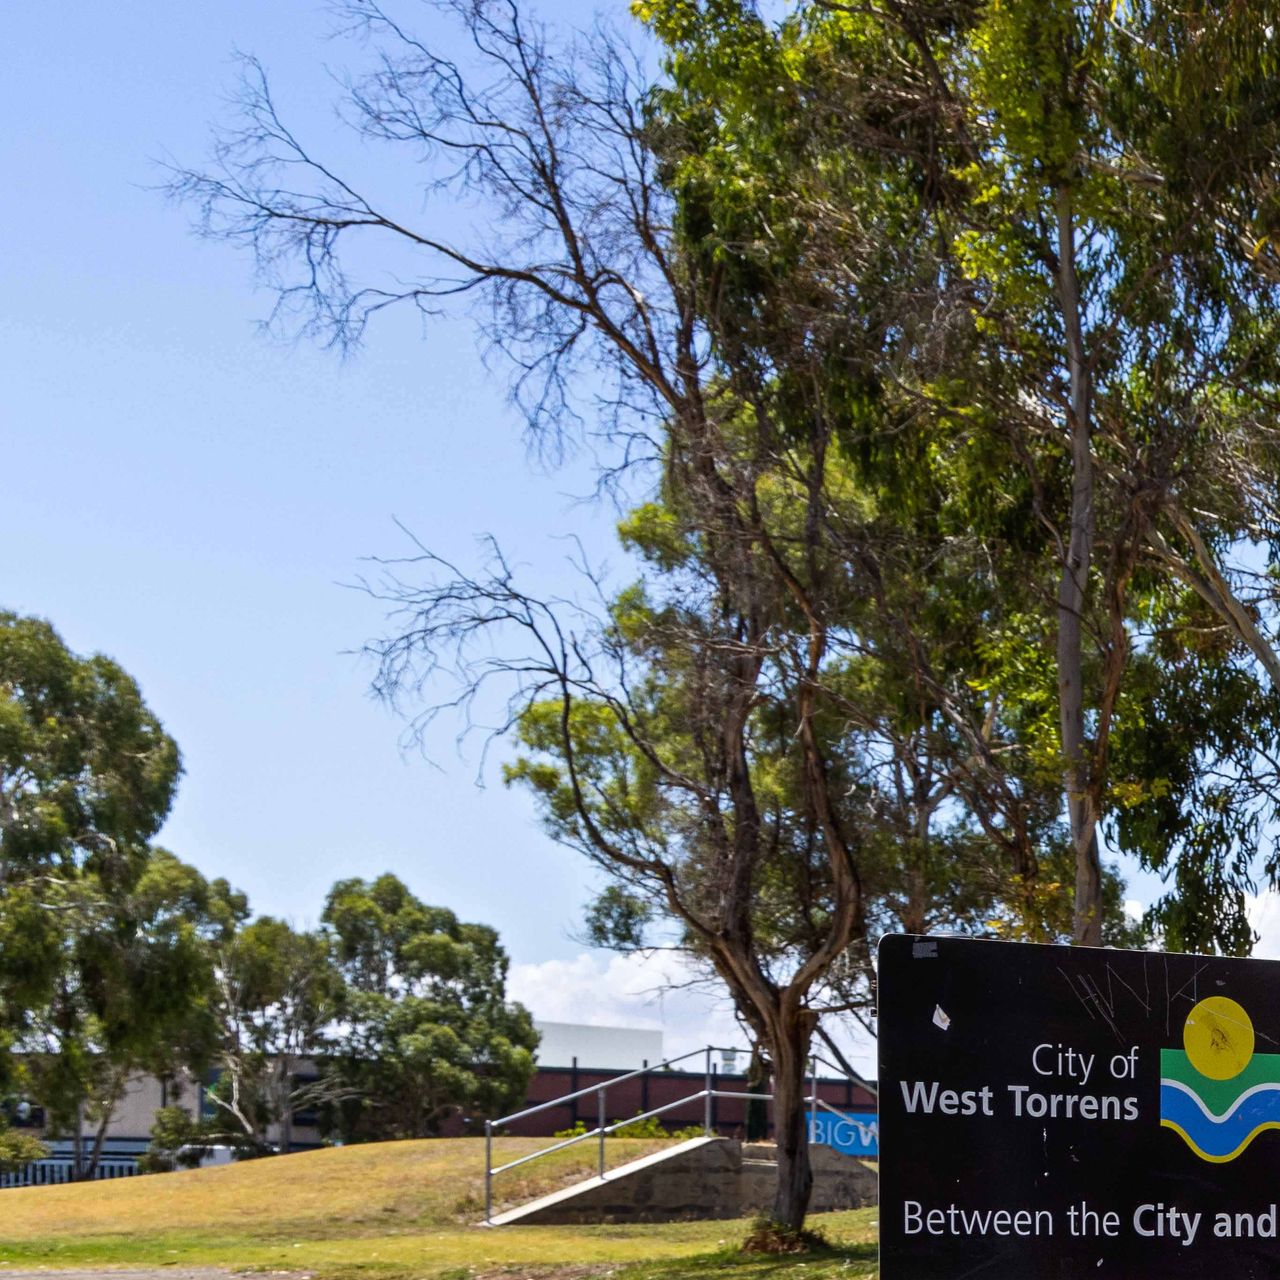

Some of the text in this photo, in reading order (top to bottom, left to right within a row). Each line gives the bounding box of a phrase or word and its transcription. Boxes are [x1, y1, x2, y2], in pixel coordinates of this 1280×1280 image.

[1033, 1043, 1139, 1083] City of
[900, 1081, 1139, 1120] West Torrens
[904, 1201, 1053, 1236] Between
[1067, 1201, 1120, 1236] the
[1133, 1203, 1202, 1246] City
[1213, 1204, 1277, 1238] and
